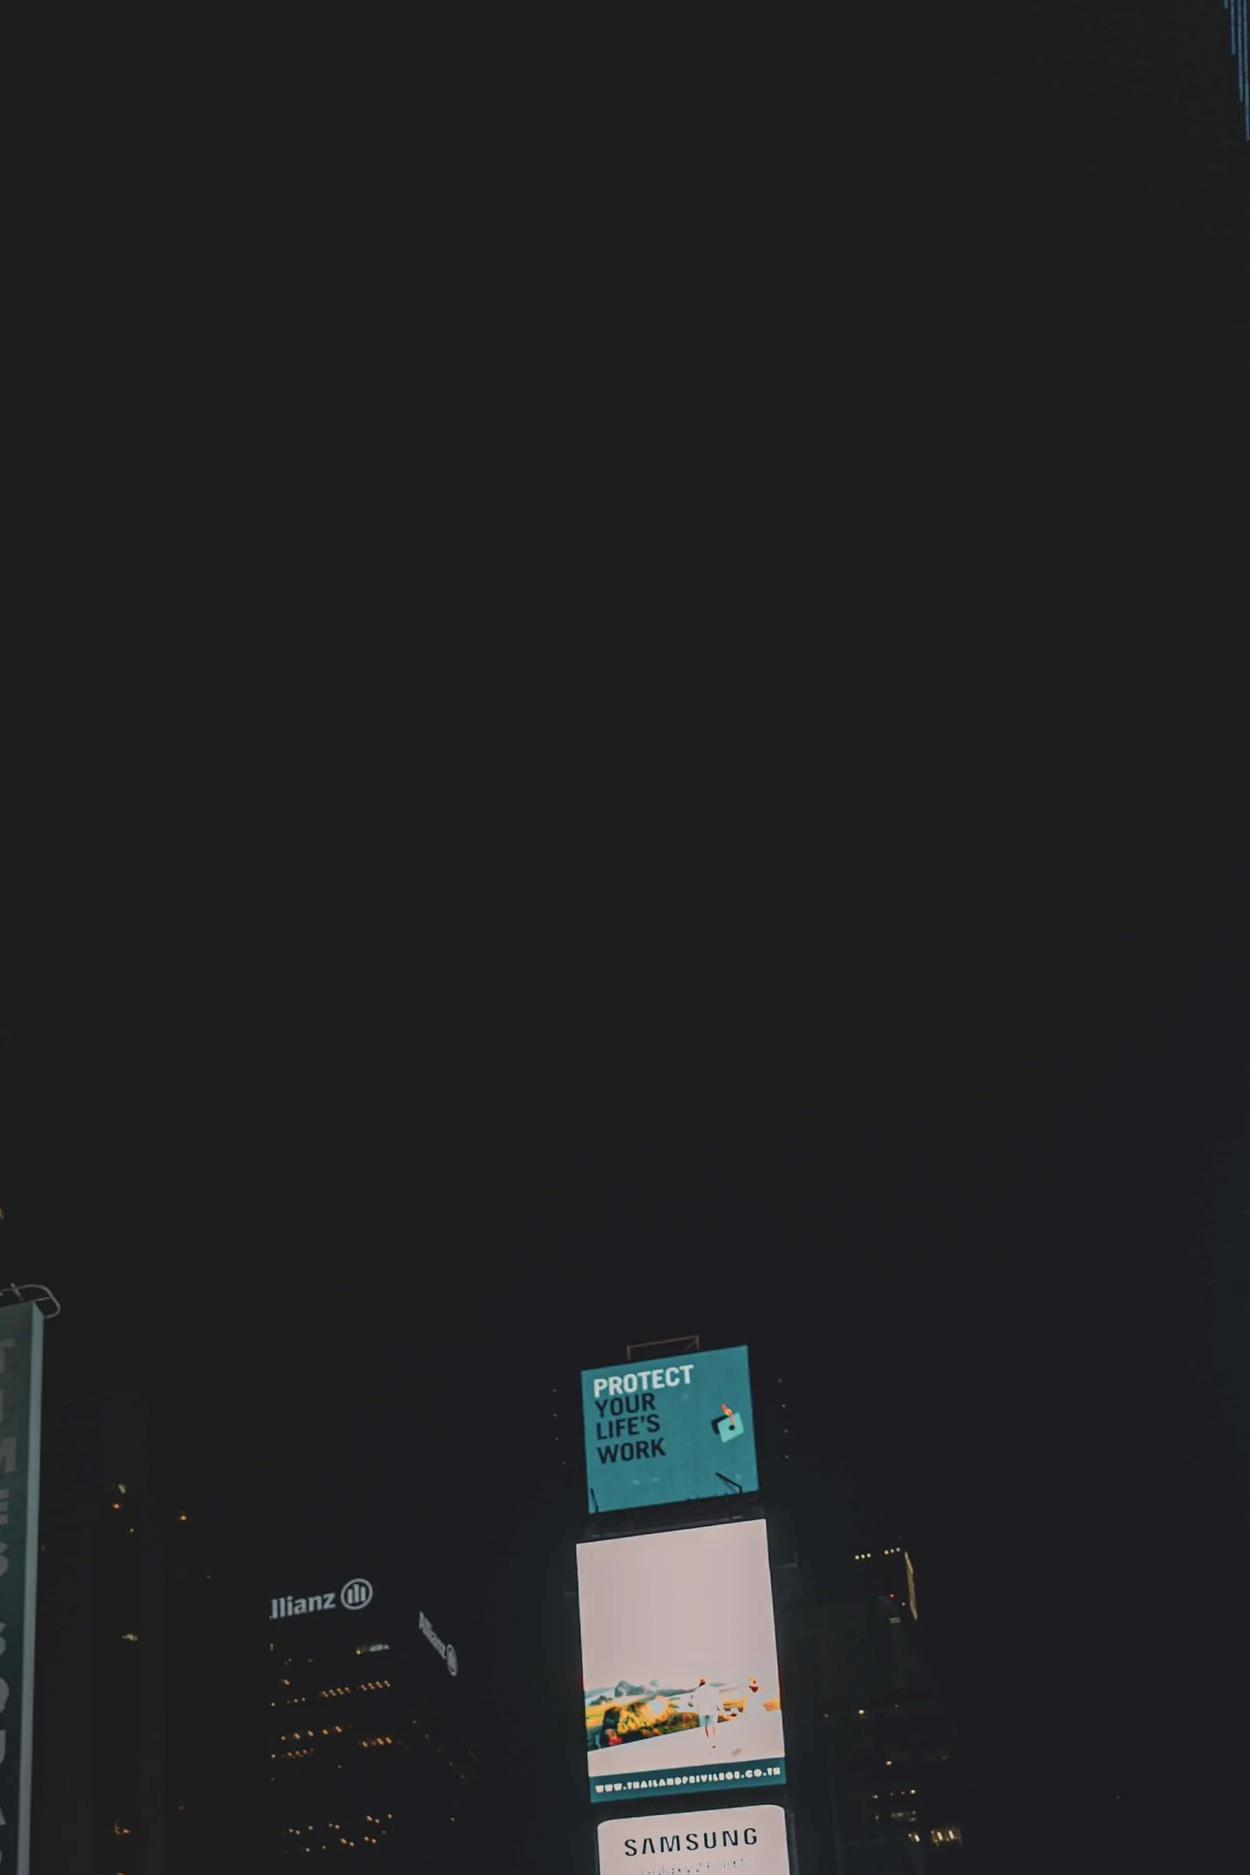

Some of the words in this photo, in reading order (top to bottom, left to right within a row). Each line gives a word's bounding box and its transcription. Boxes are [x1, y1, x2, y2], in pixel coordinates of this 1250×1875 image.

[593, 1364, 694, 1398] PROTECT
[595, 1392, 656, 1418] YOUR
[597, 1414, 661, 1440] LIFE'S
[597, 1437, 666, 1464] WORK
[269, 1591, 336, 1619] llianz
[624, 1827, 758, 1857] SAMSUNG
